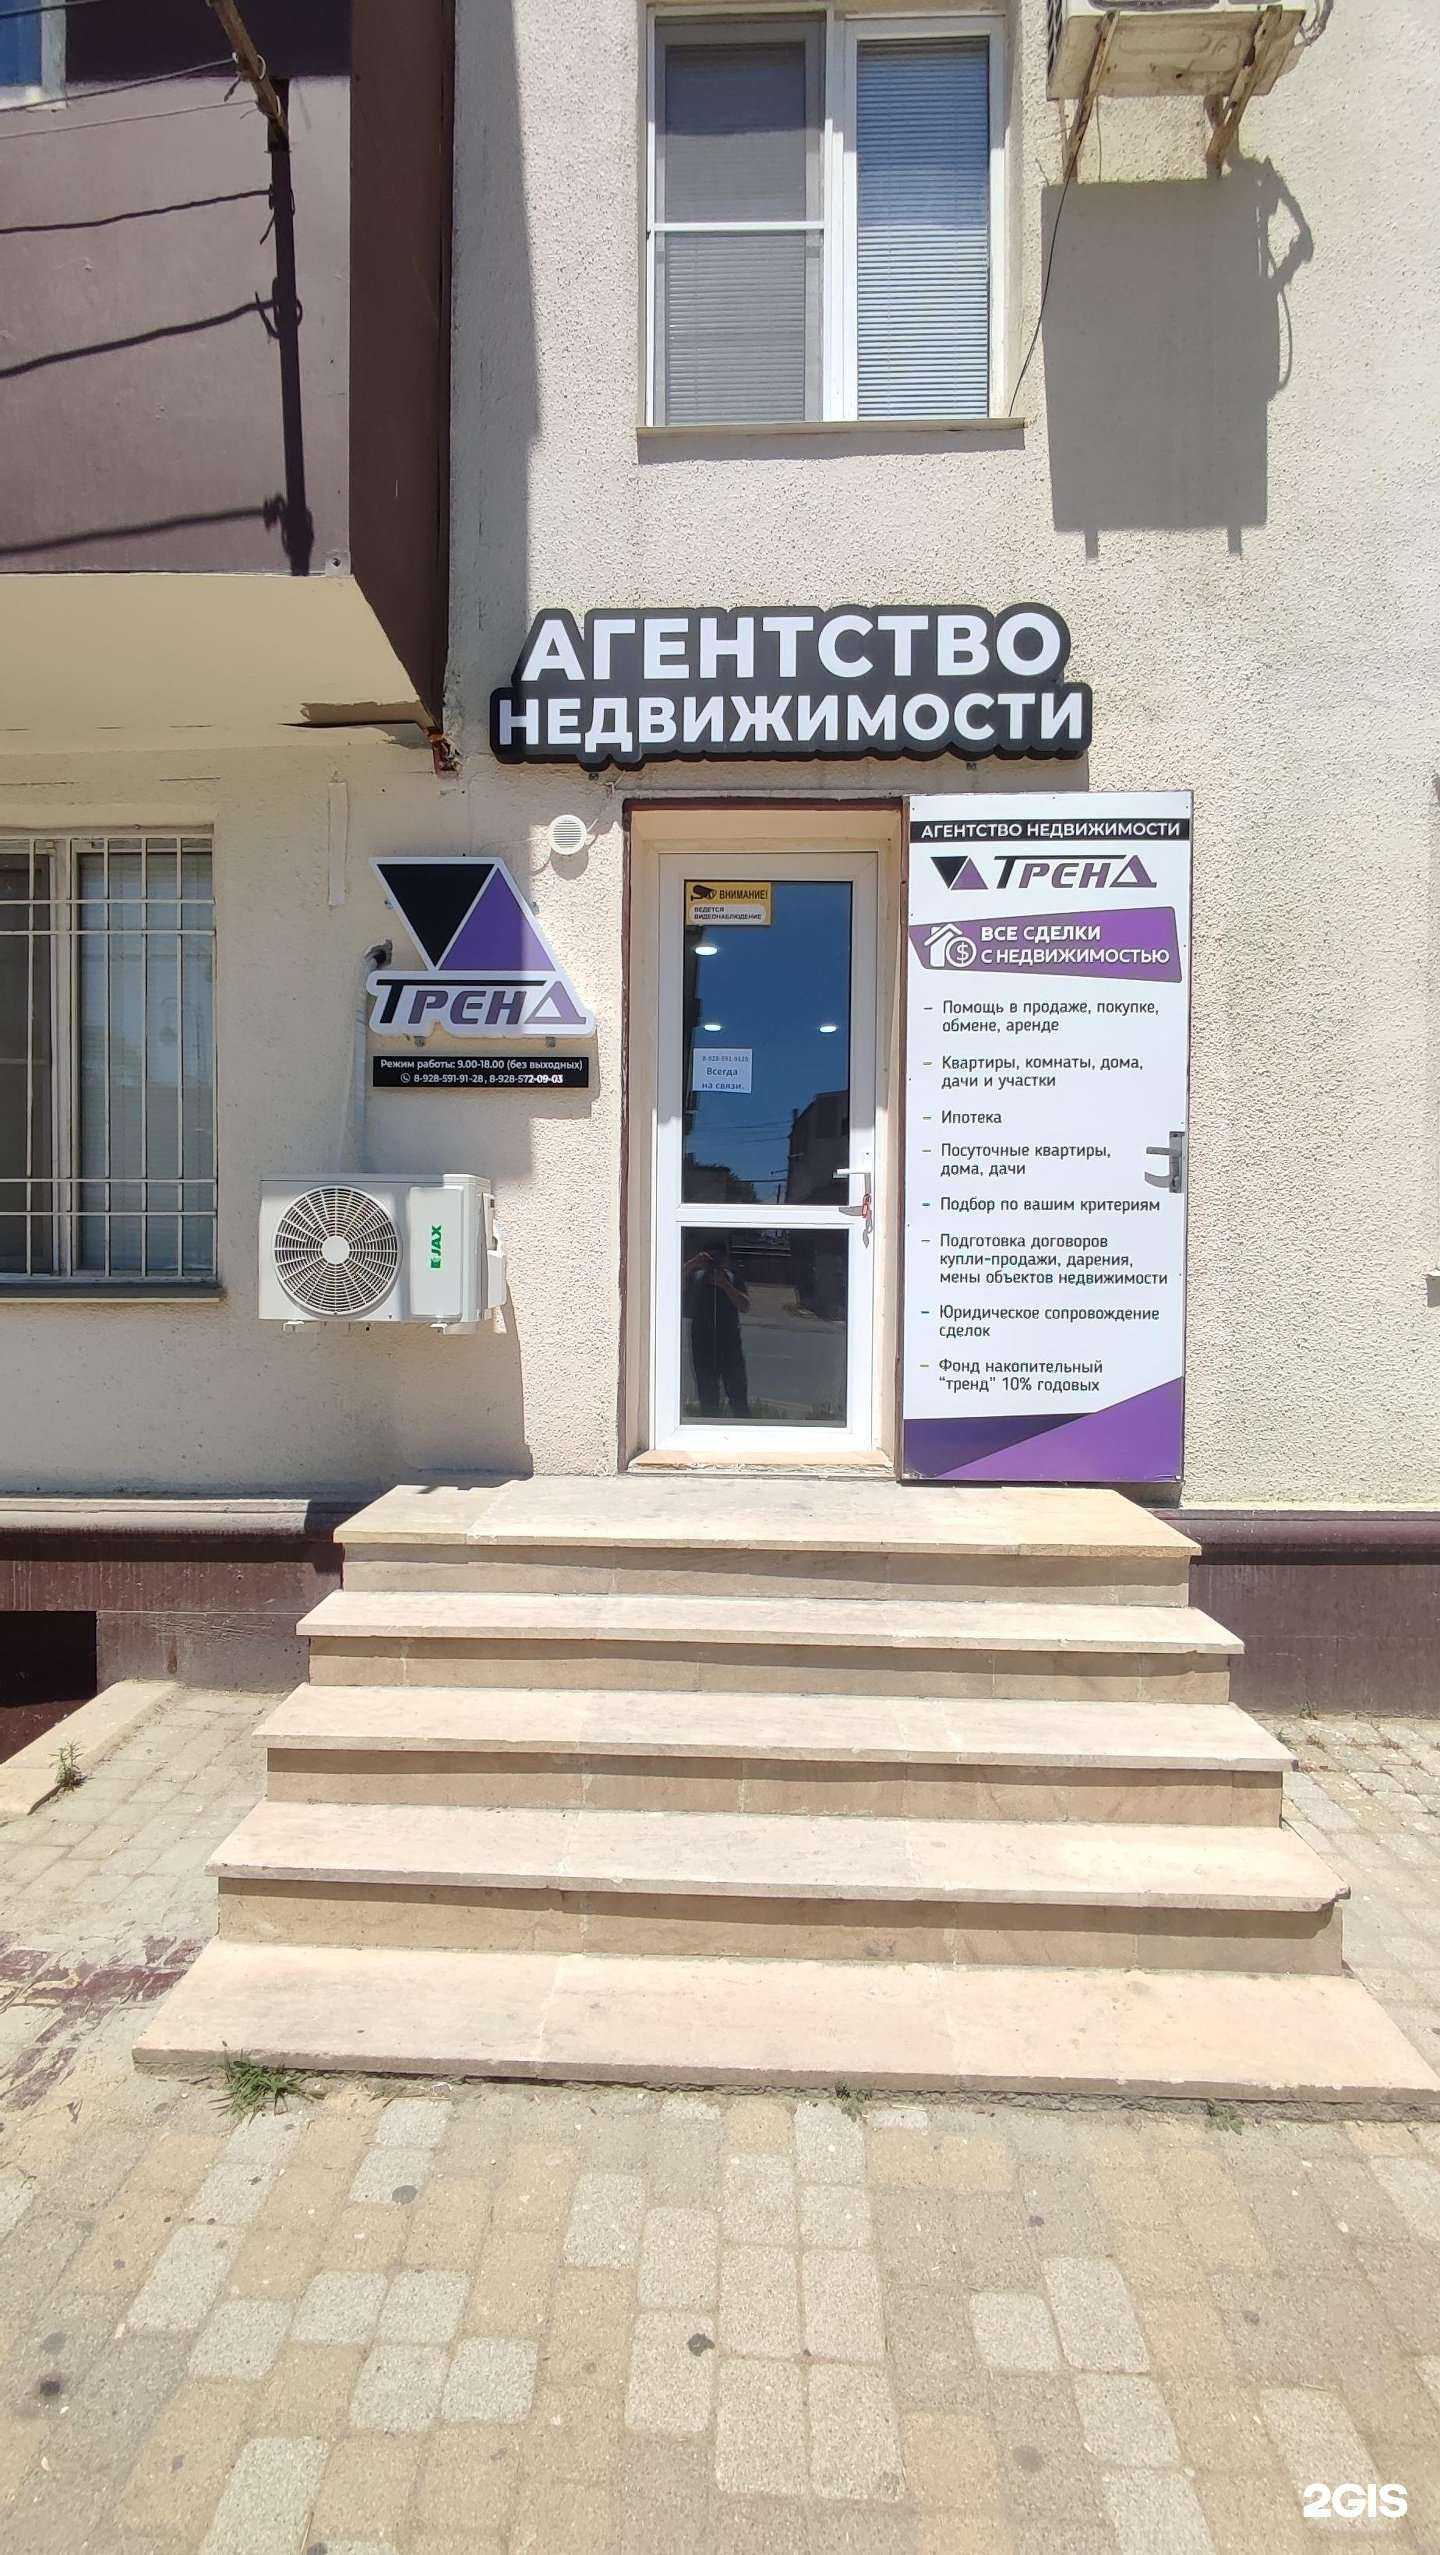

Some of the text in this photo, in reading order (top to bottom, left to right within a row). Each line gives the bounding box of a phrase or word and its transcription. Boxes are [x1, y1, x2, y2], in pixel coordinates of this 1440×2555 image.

[521, 612, 1061, 682] АГЕНТСТВО
[499, 692, 1083, 753] НЕДВИЖИМОСТИ
[921, 821, 1181, 839] АГЕНТСТВО НЕДВИЖИМОСТИ
[719, 889, 769, 900] ВНИМАНИЕ!
[981, 926, 1101, 943] ВСЕ СДЕЛКИ
[981, 949, 1170, 966] С НЕДВИЖИМОСТЬЮ
[942, 1000, 1159, 1017] Помощь в продаже, покупке,
[942, 1018, 1060, 1034] обмене, аренде
[380, 1059, 583, 1071] Режим работы: 9.00-18.00 (без выходных)
[942, 1056, 1144, 1071] Квартиры, комнаты, дома,
[489, 1074, 564, 1084] 8-928-572-09-03
[706, 1067, 738, 1077] Всегда
[941, 1076, 1056, 1090] дачи и участки
[941, 1110, 1002, 1125] Ипотека
[941, 1143, 1111, 1160] Посуточные квартиры,
[940, 1164, 1026, 1177] дома, дачи
[940, 1196, 1161, 1214] Подбор по вашим критериям
[940, 1233, 1109, 1251] Подготовка договоров
[940, 1255, 1133, 1269] купли-продажи, дарения,
[940, 1270, 1168, 1286] мены объектов недвижимости
[939, 1304, 1160, 1323] Юридическое сопровождение
[939, 1325, 991, 1339] сделок
[939, 1359, 1103, 1374] Фонд накопительный
[1003, 1377, 1032, 1391] 10%
[1037, 1380, 1100, 1393] годовых
